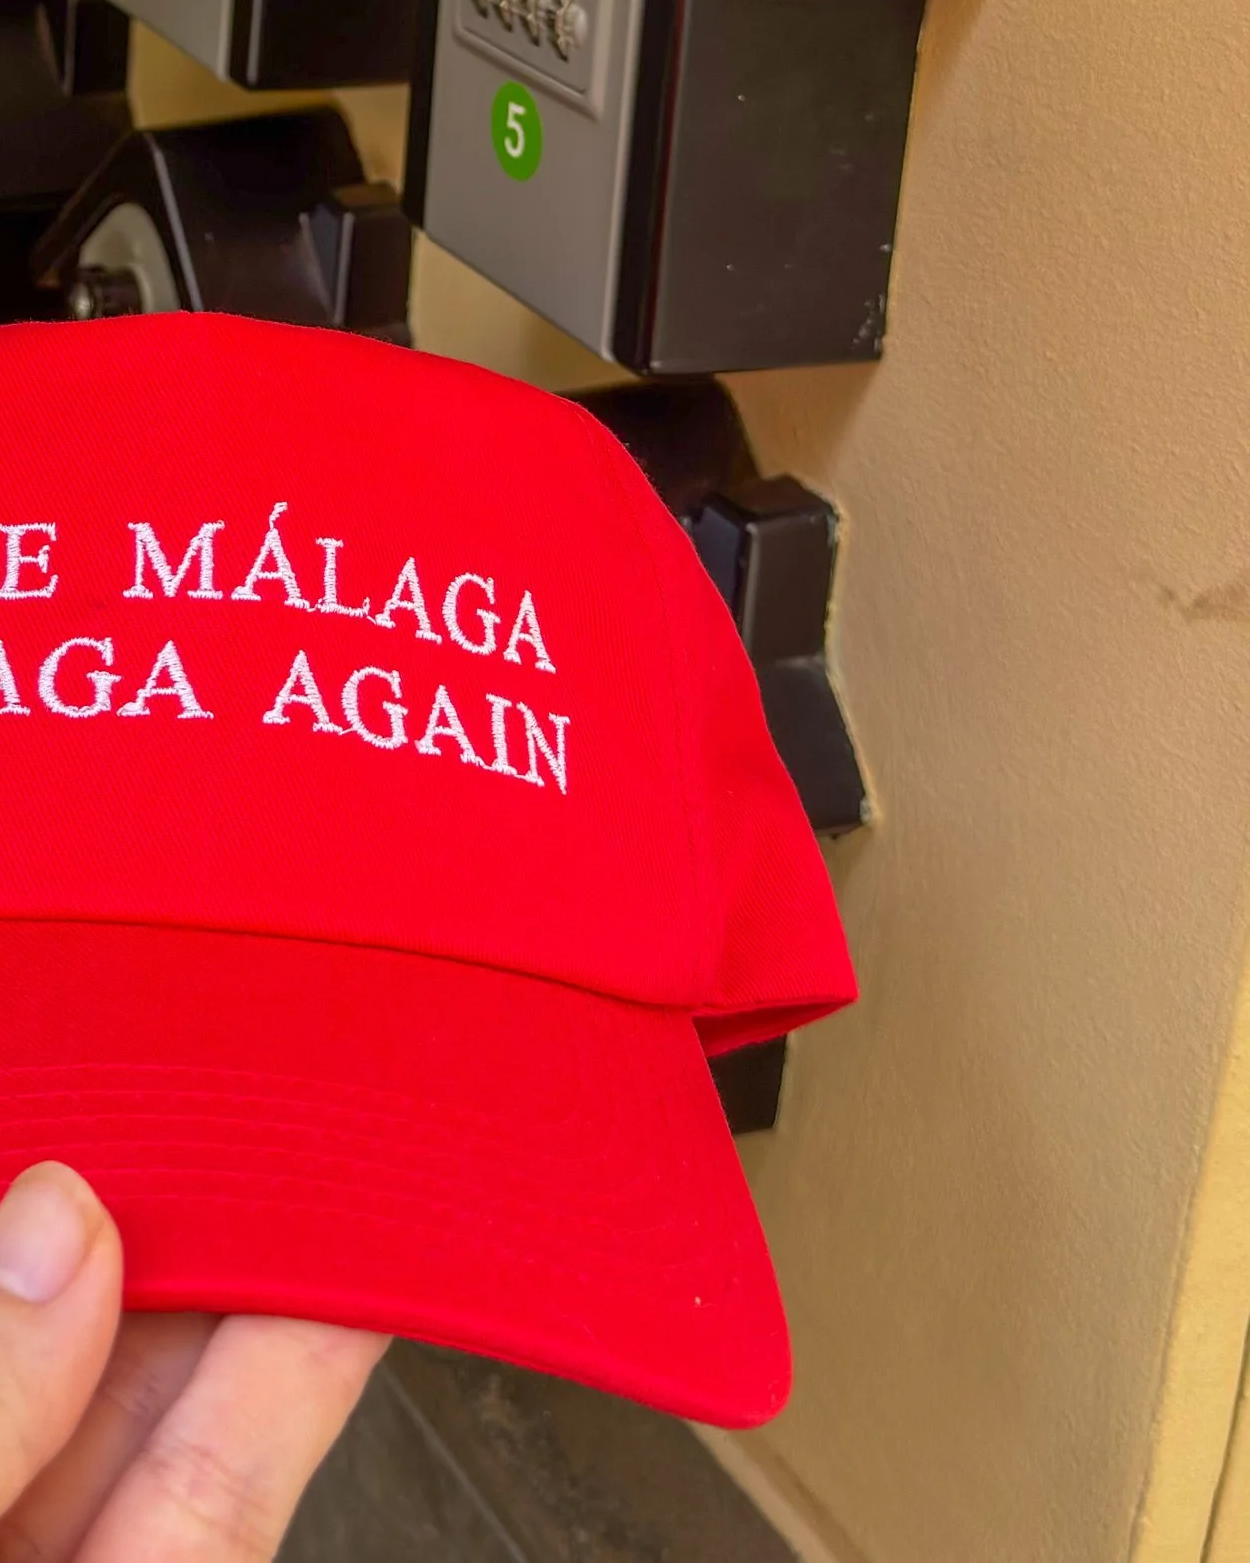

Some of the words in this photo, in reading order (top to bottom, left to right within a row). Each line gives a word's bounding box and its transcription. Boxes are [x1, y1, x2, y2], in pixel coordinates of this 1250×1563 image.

[504, 100, 526, 159] 5
[123, 501, 557, 674] MÁLAGA
[262, 649, 571, 795] AGAIN
